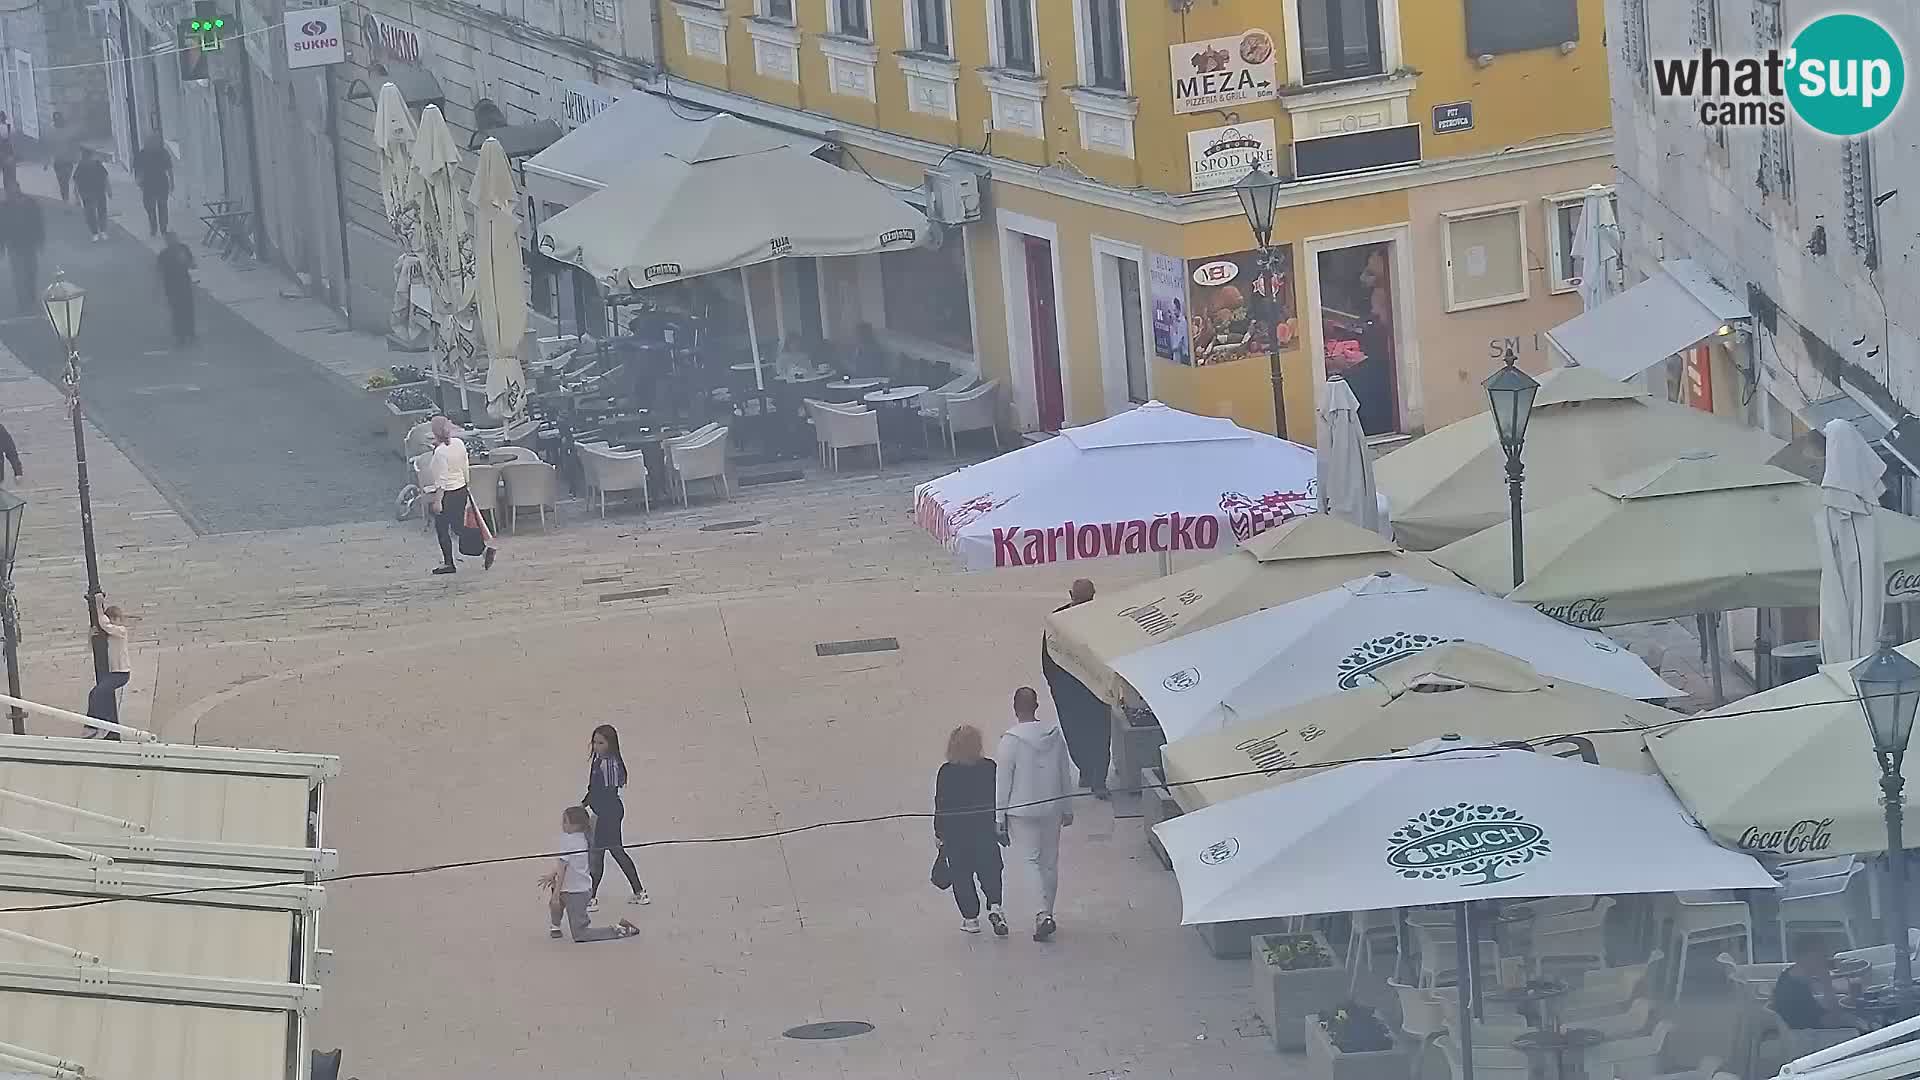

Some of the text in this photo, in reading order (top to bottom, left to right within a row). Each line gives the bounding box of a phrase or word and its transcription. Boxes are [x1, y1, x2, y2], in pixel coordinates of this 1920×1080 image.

[294, 38, 338, 52] SUKNO
[380, 21, 420, 61] SUKNO
[1176, 69, 1256, 100] MEZA
[1185, 94, 1218, 107] PIZZERIA
[1225, 90, 1248, 102] GRILL
[1194, 153, 1241, 173] ISPOD
[992, 511, 1220, 568] Karlovačko
[1426, 827, 1526, 859] RAUCH
